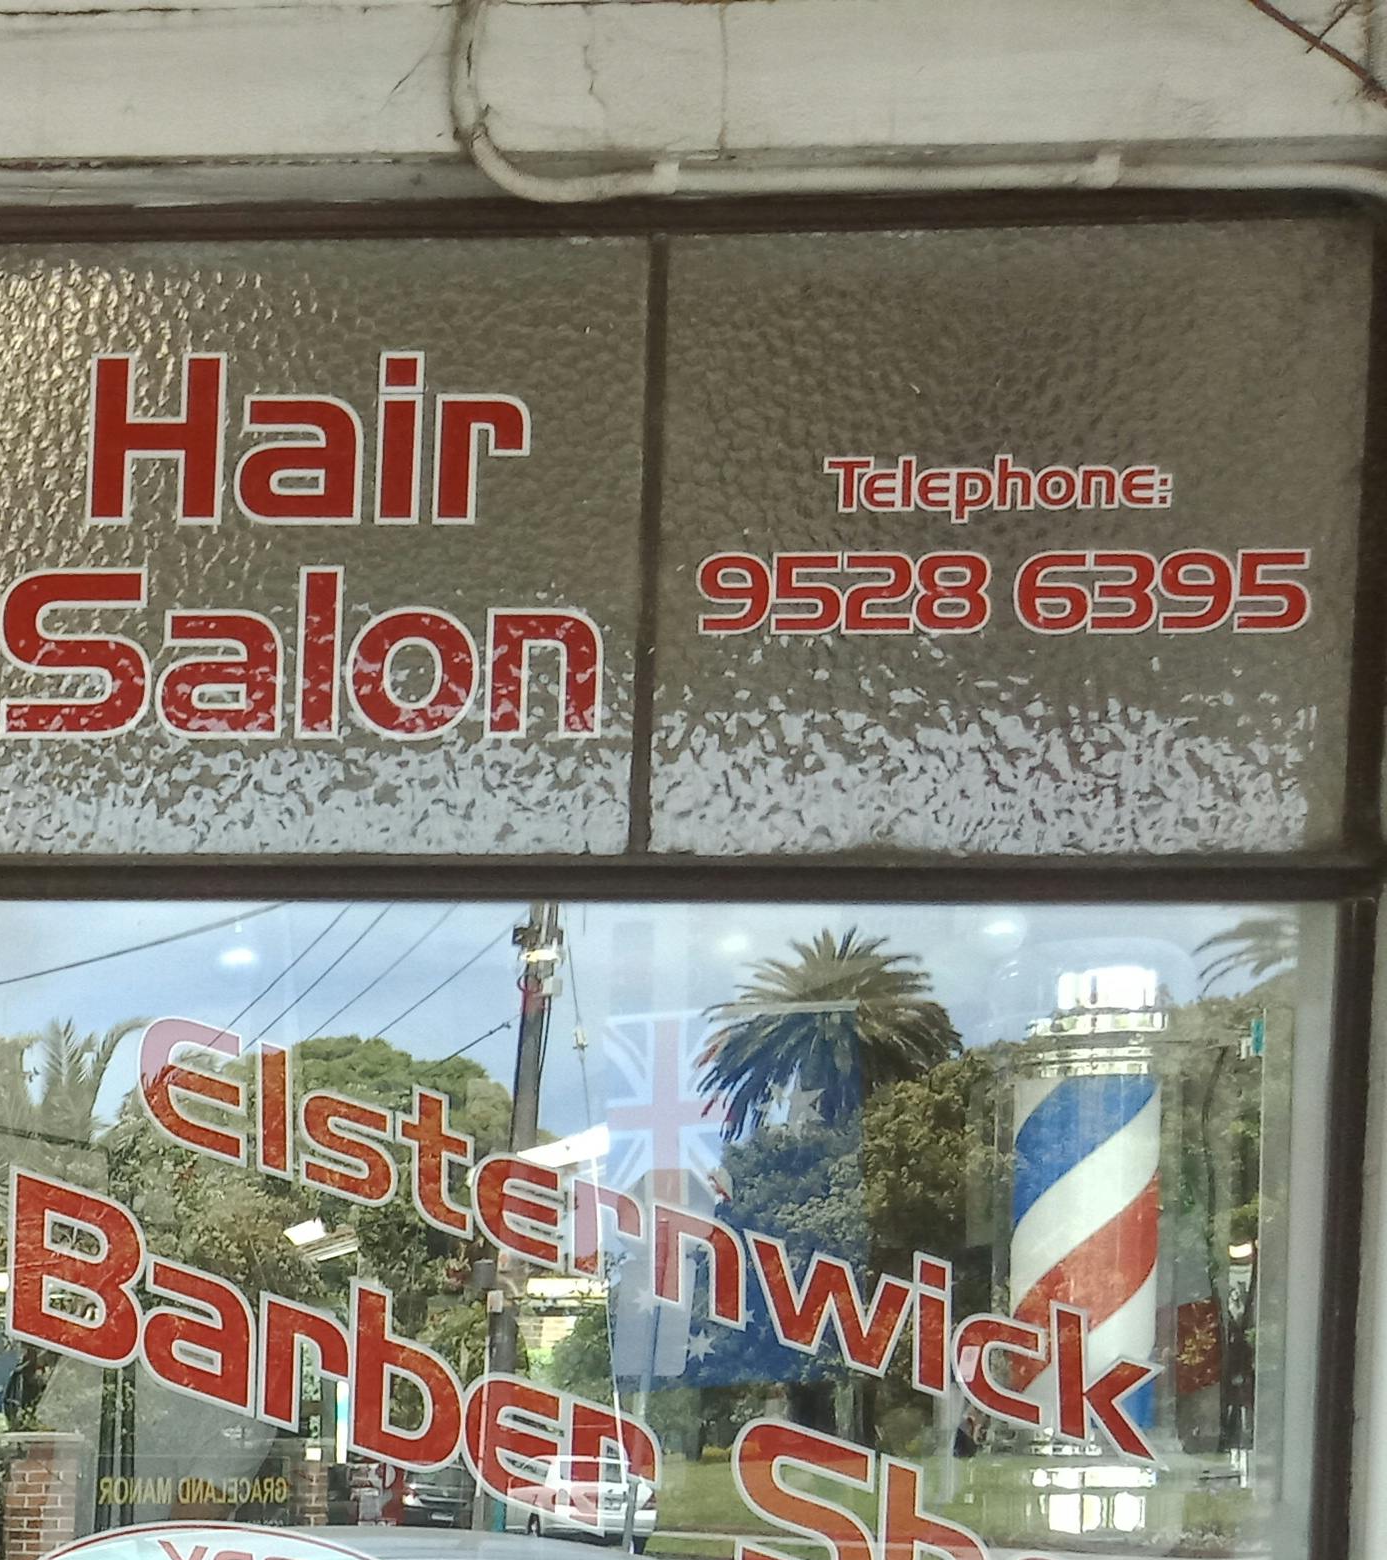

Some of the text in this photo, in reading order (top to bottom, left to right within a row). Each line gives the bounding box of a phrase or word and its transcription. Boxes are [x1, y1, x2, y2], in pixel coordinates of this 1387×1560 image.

[84, 350, 531, 527] Hair
[823, 454, 1173, 524] Telephone:
[696, 548, 1312, 636] 9528 6395
[138, 1015, 1163, 1468] Elsternwick
[7, 1167, 661, 1533] Barber
